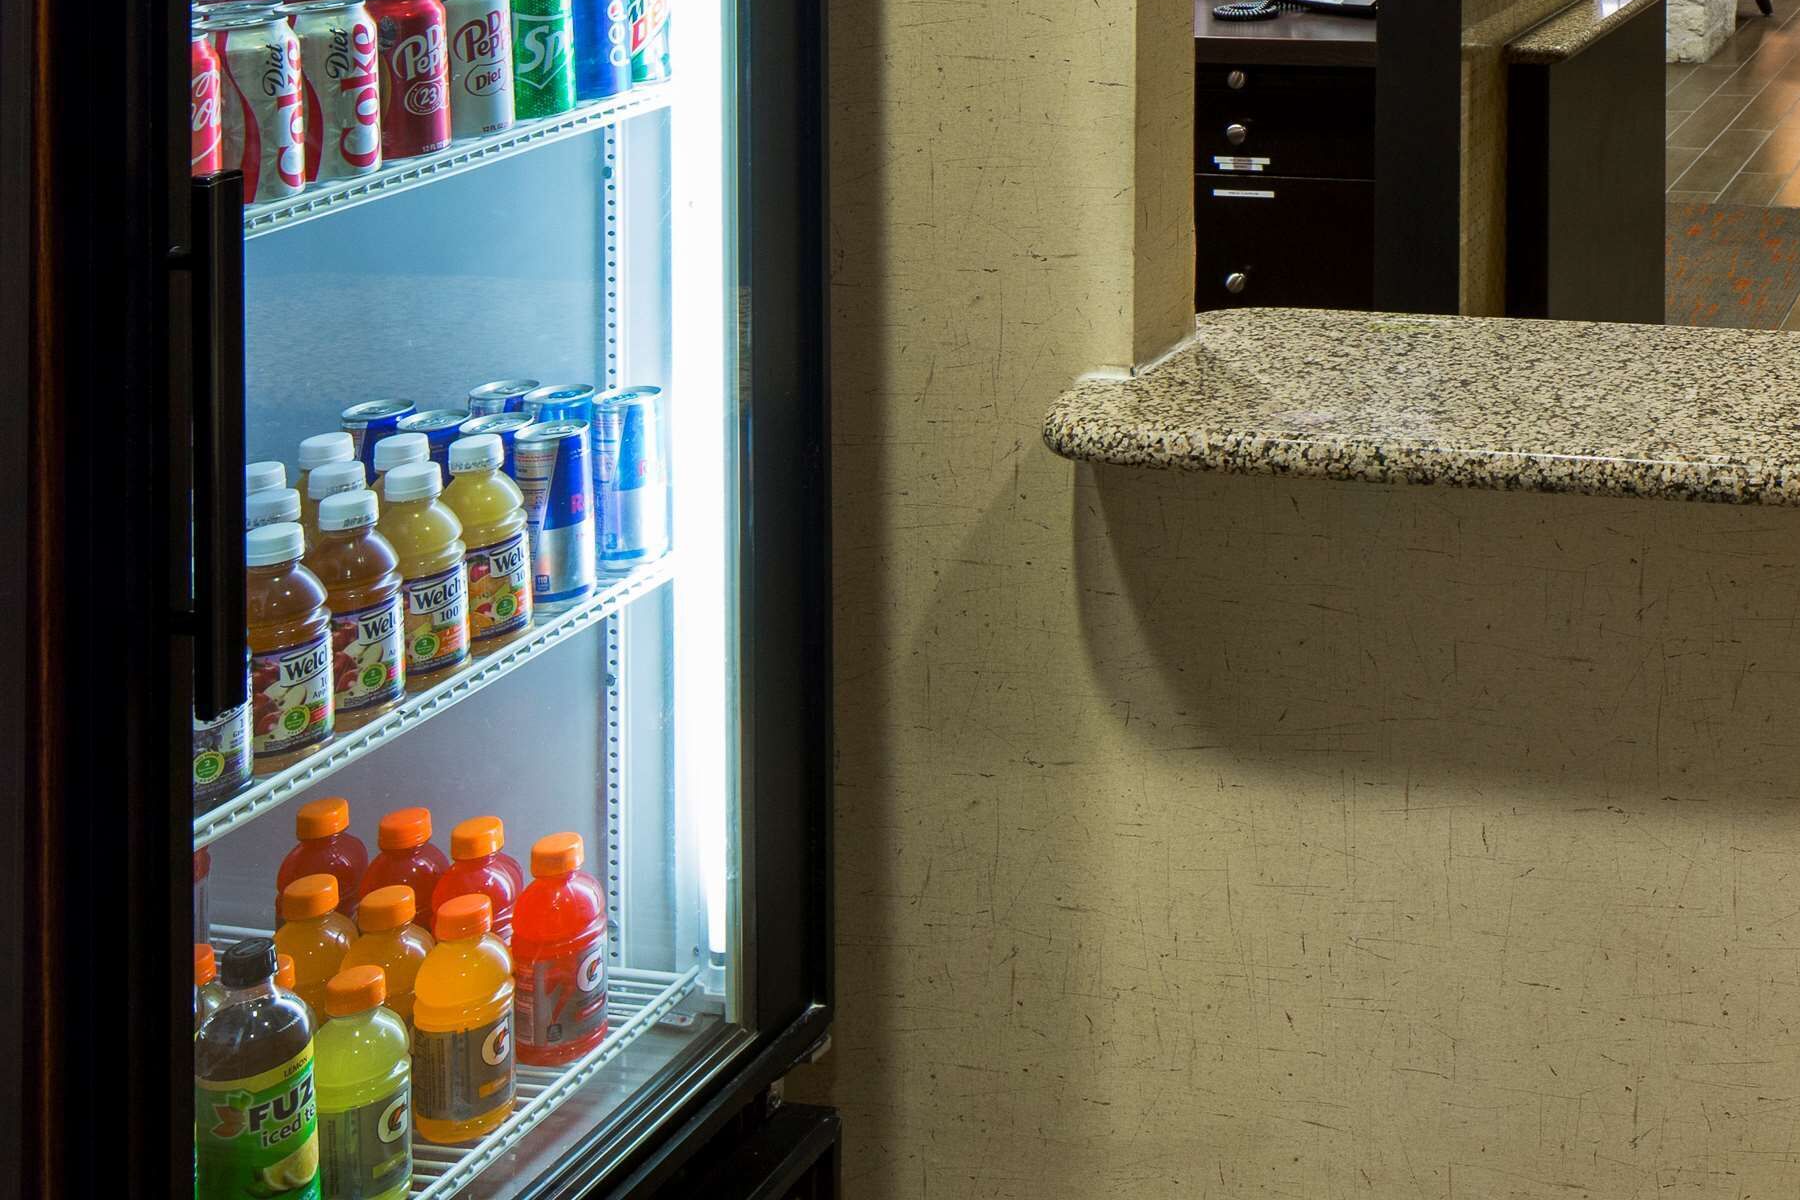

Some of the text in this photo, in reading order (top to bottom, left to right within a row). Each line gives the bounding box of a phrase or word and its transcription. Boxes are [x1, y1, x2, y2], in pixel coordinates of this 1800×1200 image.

[262, 44, 285, 97] Diet
[325, 27, 351, 80] Diet
[475, 67, 503, 91] Diet
[338, 22, 380, 168] Coke
[418, 87, 437, 105] 23
[481, 1016, 511, 1067] G
[282, 1055, 309, 1080] LEMON
[261, 1118, 301, 1150] iced
[377, 1087, 408, 1145] G
